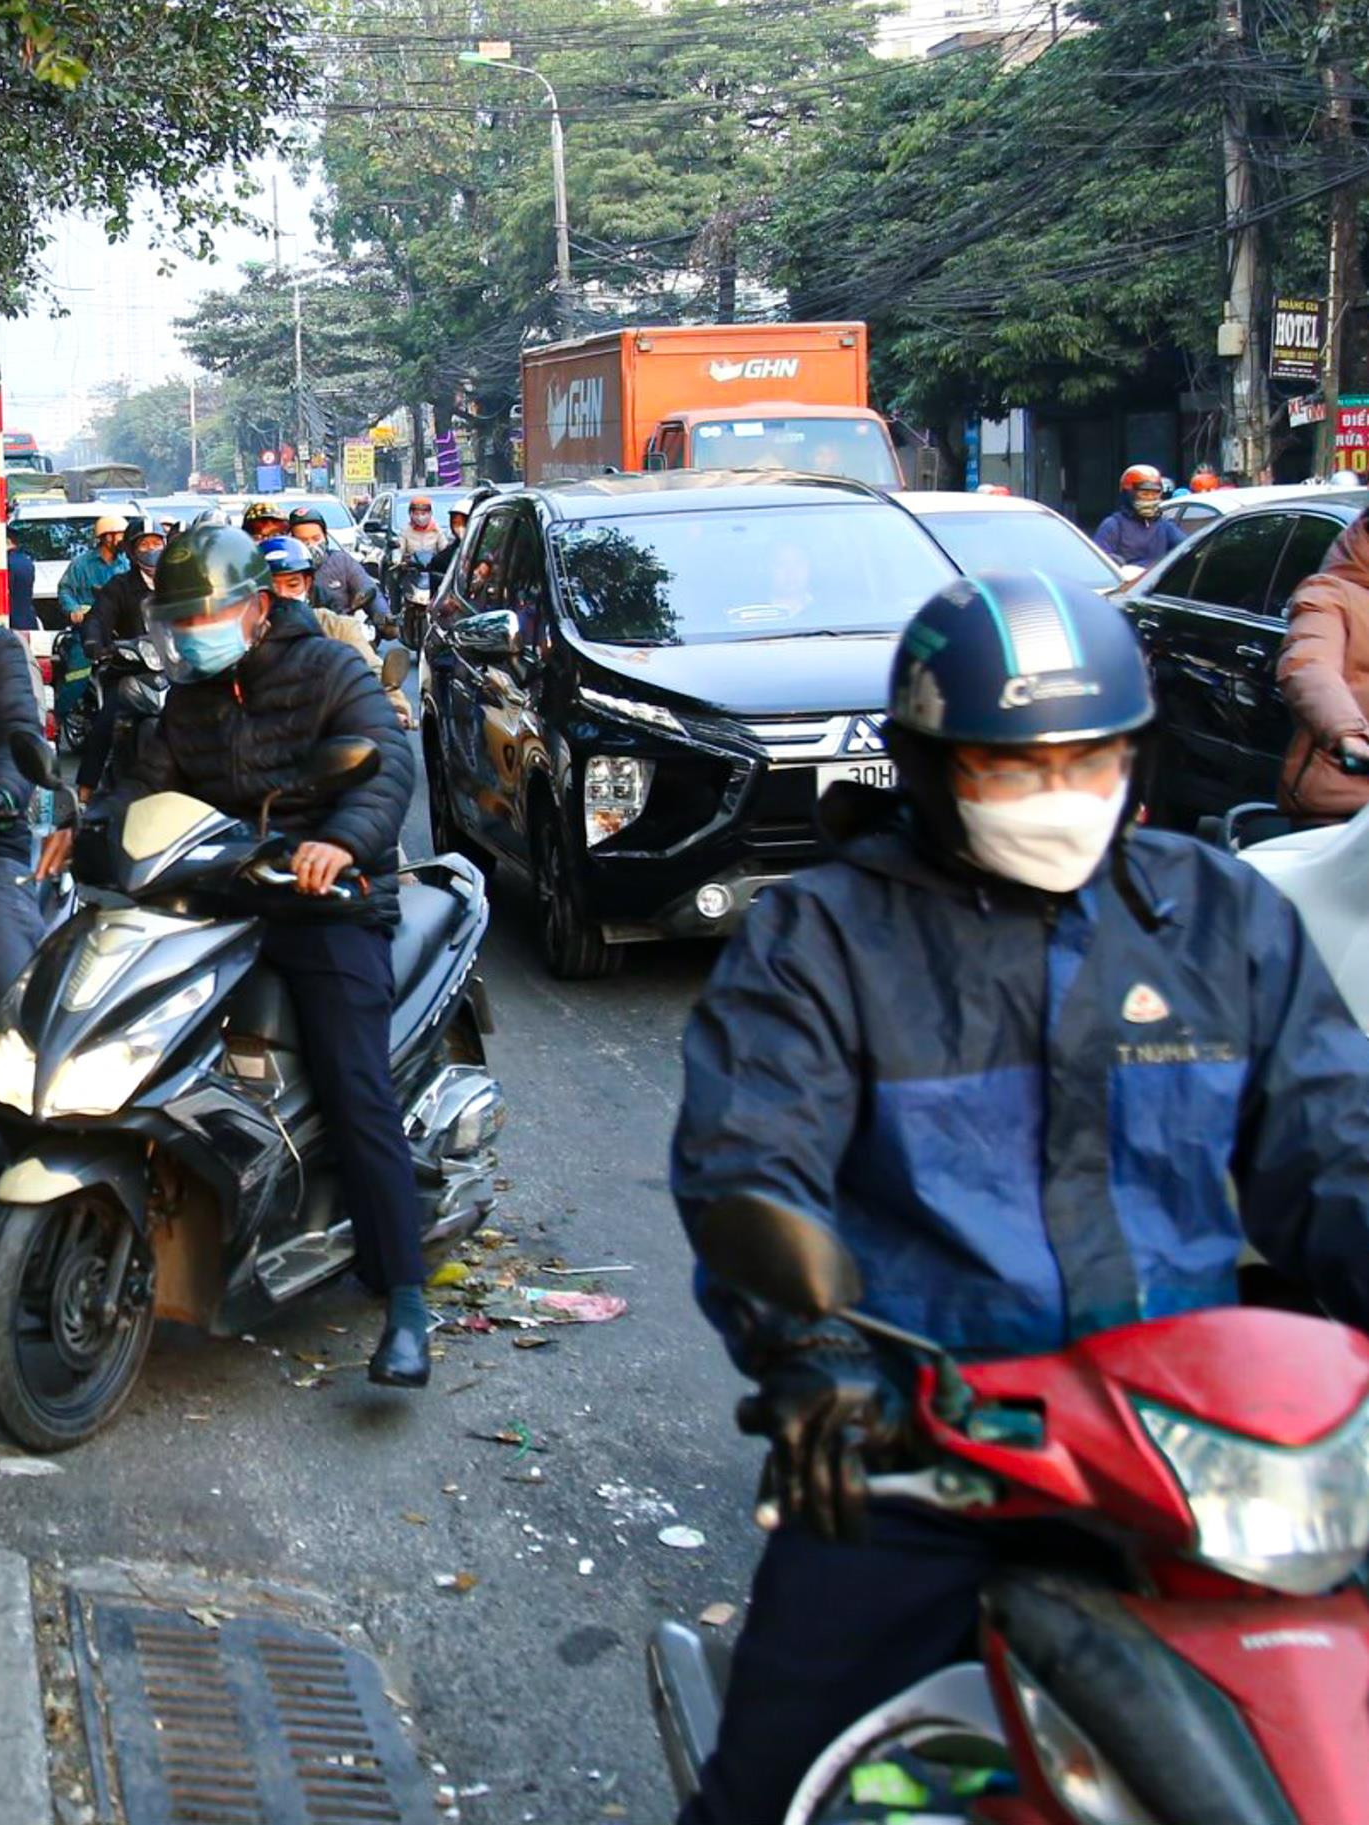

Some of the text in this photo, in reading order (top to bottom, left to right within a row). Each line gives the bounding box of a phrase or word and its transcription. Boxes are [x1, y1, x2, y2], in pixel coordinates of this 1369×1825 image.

[1274, 312, 1320, 349] HOTEL
[743, 358, 799, 379] GHN
[567, 377, 604, 440] GHN
[848, 765, 893, 787] 30H
